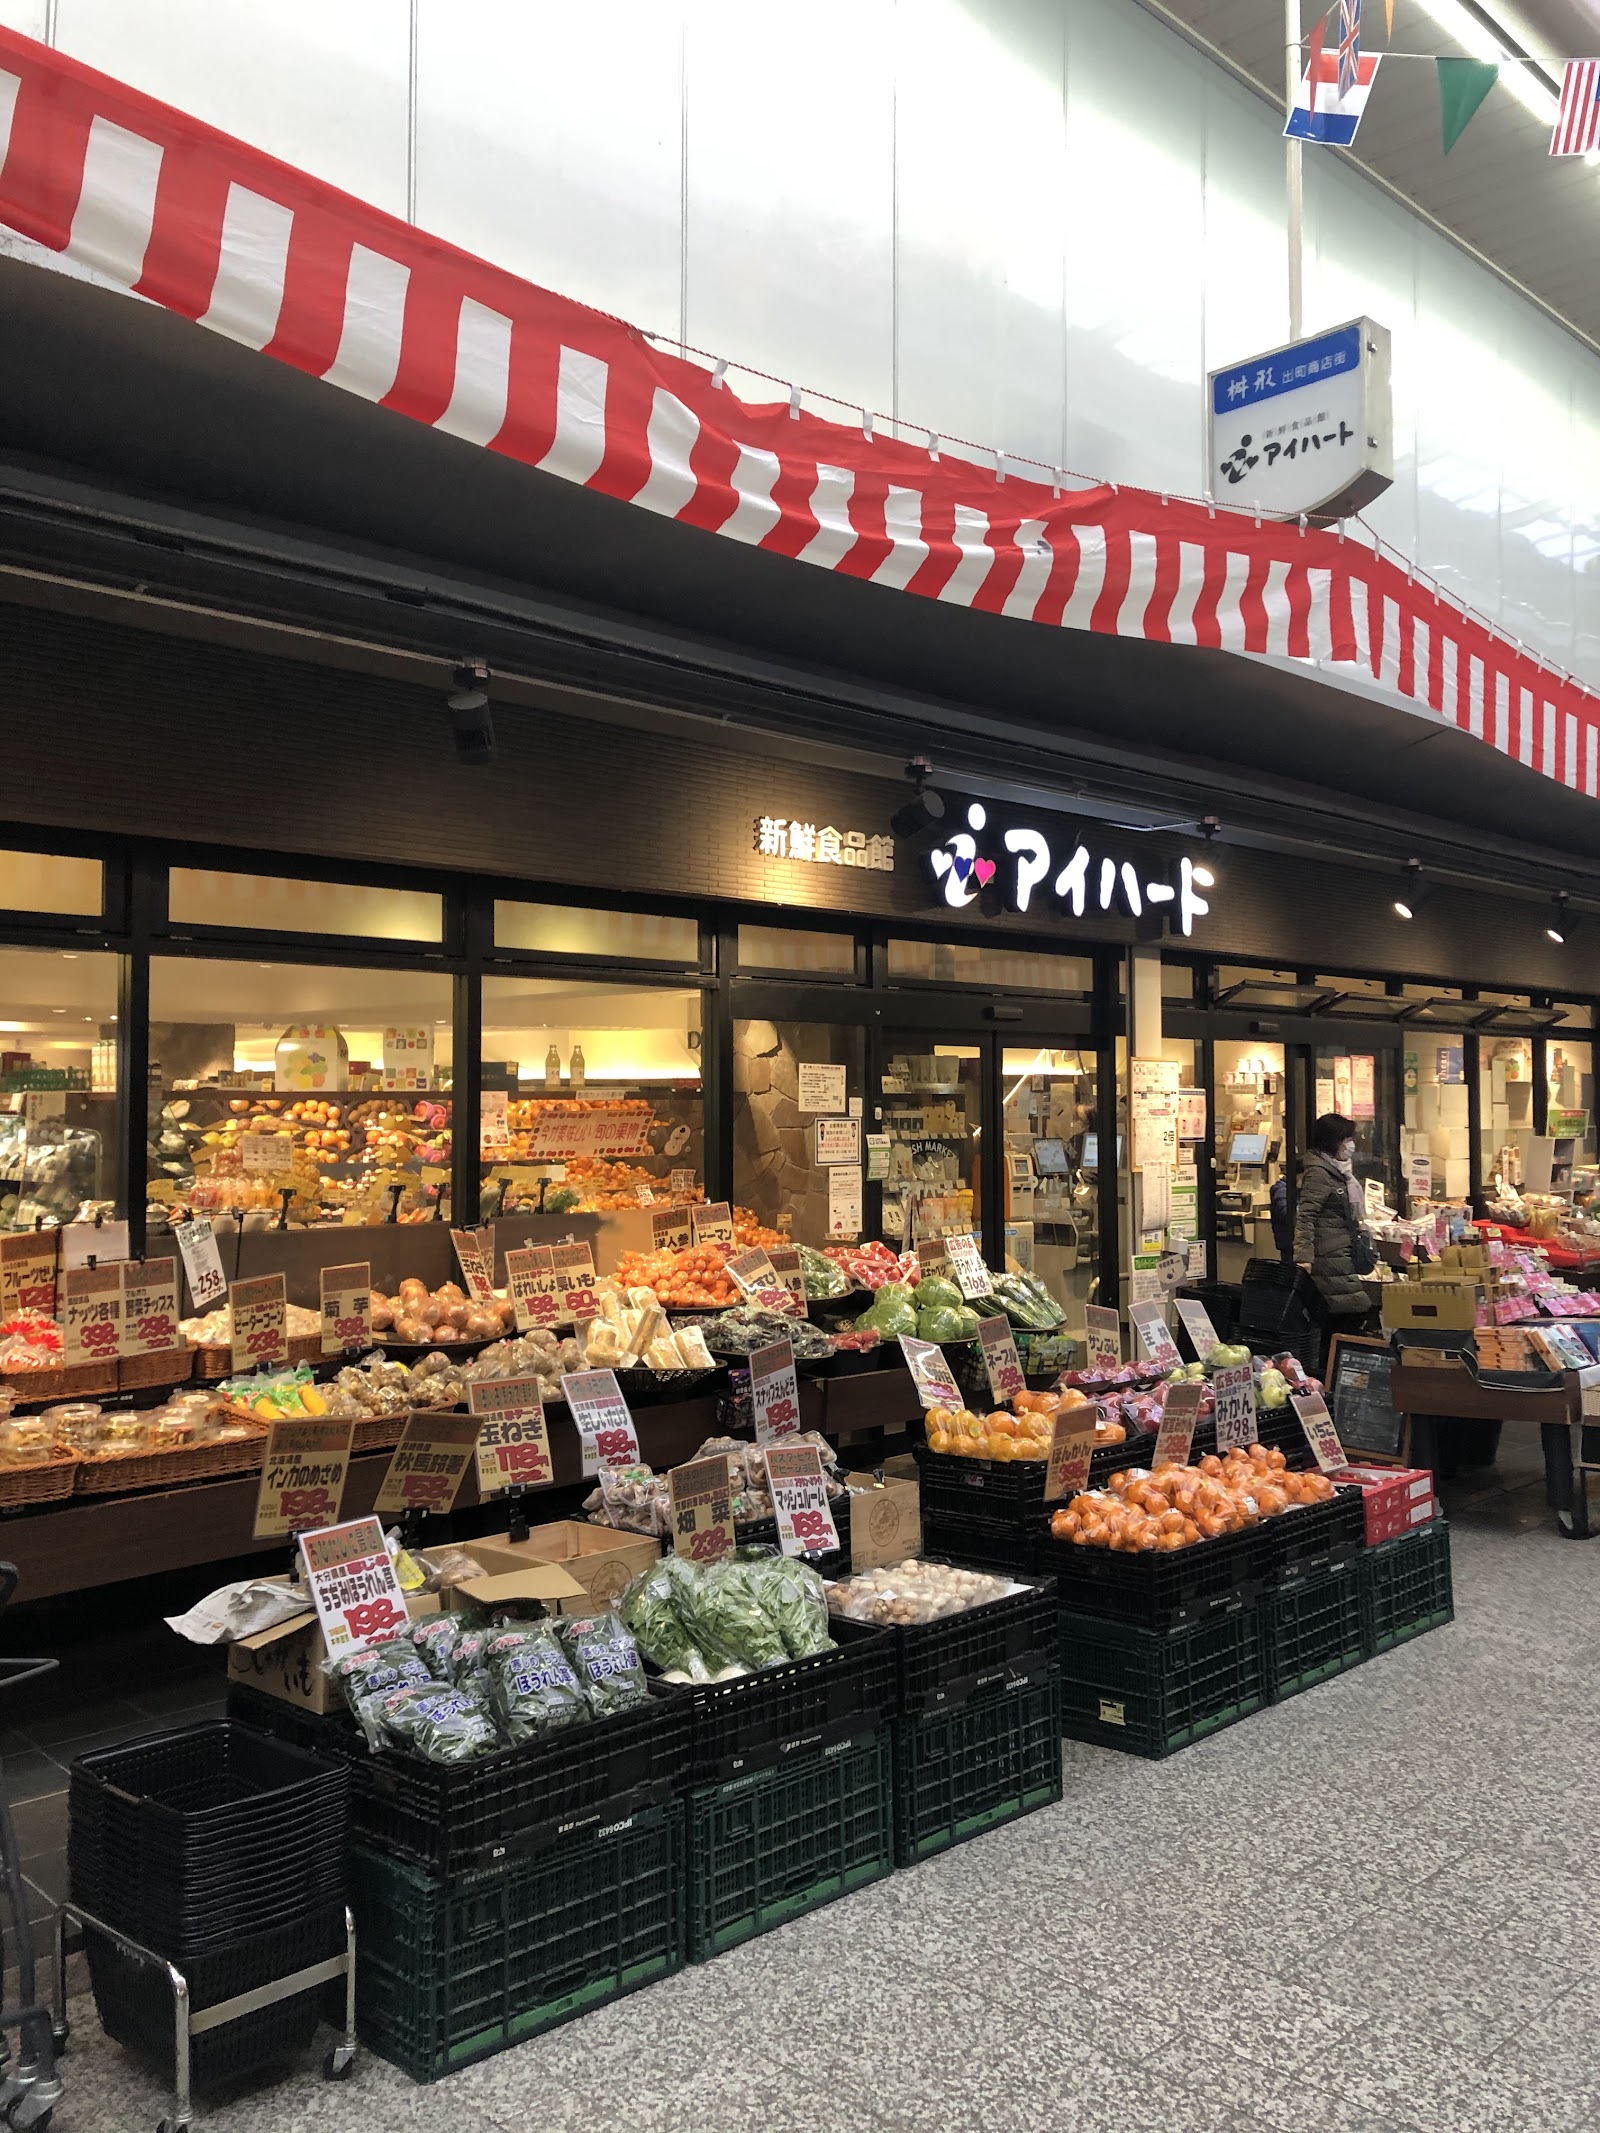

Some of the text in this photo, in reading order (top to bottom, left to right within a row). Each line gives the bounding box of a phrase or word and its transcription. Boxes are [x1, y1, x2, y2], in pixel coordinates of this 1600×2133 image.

[1282, 351, 1347, 385] 出町商店街
[1263, 420, 1354, 466] アイハート
[757, 816, 895, 872] 新鮮食品館
[1004, 828, 1212, 937] アイハート
[541, 1121, 641, 1145] 今が美味しい 旬の果物
[698, 1229, 732, 1244] ピーマン
[513, 1279, 555, 1298] ばれいしょ
[556, 1273, 595, 1292] 長いも
[68, 1299, 120, 1326] ナッツ各種
[1216, 1366, 1252, 1391] 広告の品
[1217, 1393, 1253, 1423] みかん
[480, 1418, 543, 1447] 玉ねぎ
[267, 1463, 343, 1490] インカのめざめ
[775, 1487, 826, 1511] マッシュルーム
[588, 1650, 638, 1681] ほうれん草
[516, 1666, 575, 1695] ほうれん草
